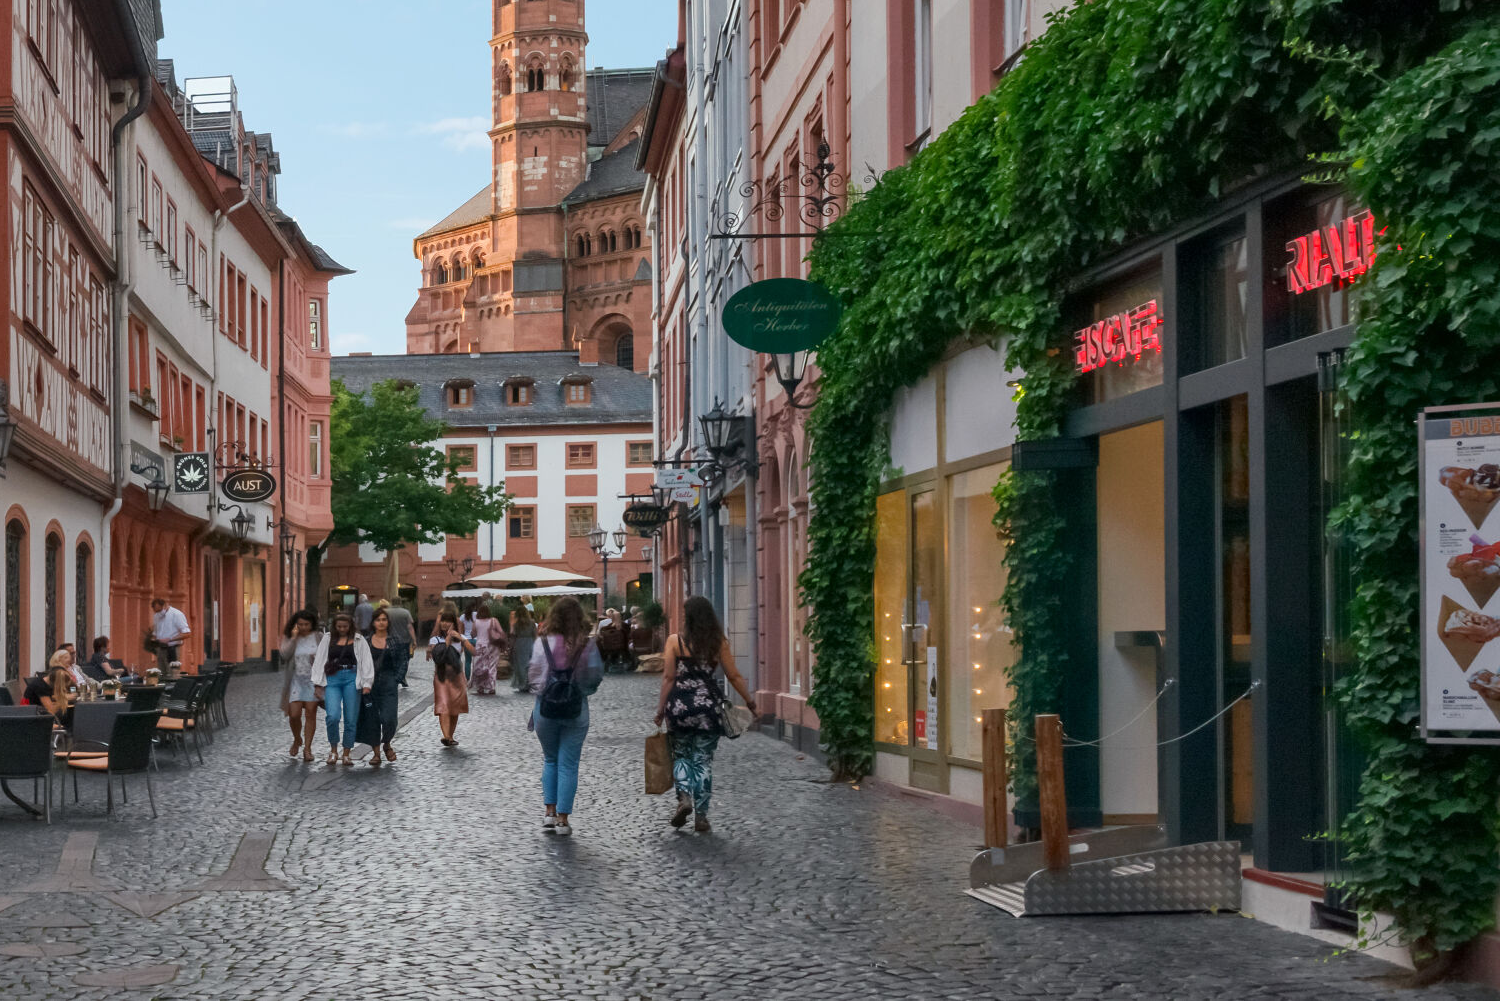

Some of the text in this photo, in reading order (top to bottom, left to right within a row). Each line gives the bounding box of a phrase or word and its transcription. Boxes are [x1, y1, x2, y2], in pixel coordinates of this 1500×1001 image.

[1285, 209, 1380, 295] RIALT
[196, 456, 208, 469] GOLD
[233, 479, 263, 491] AUST
